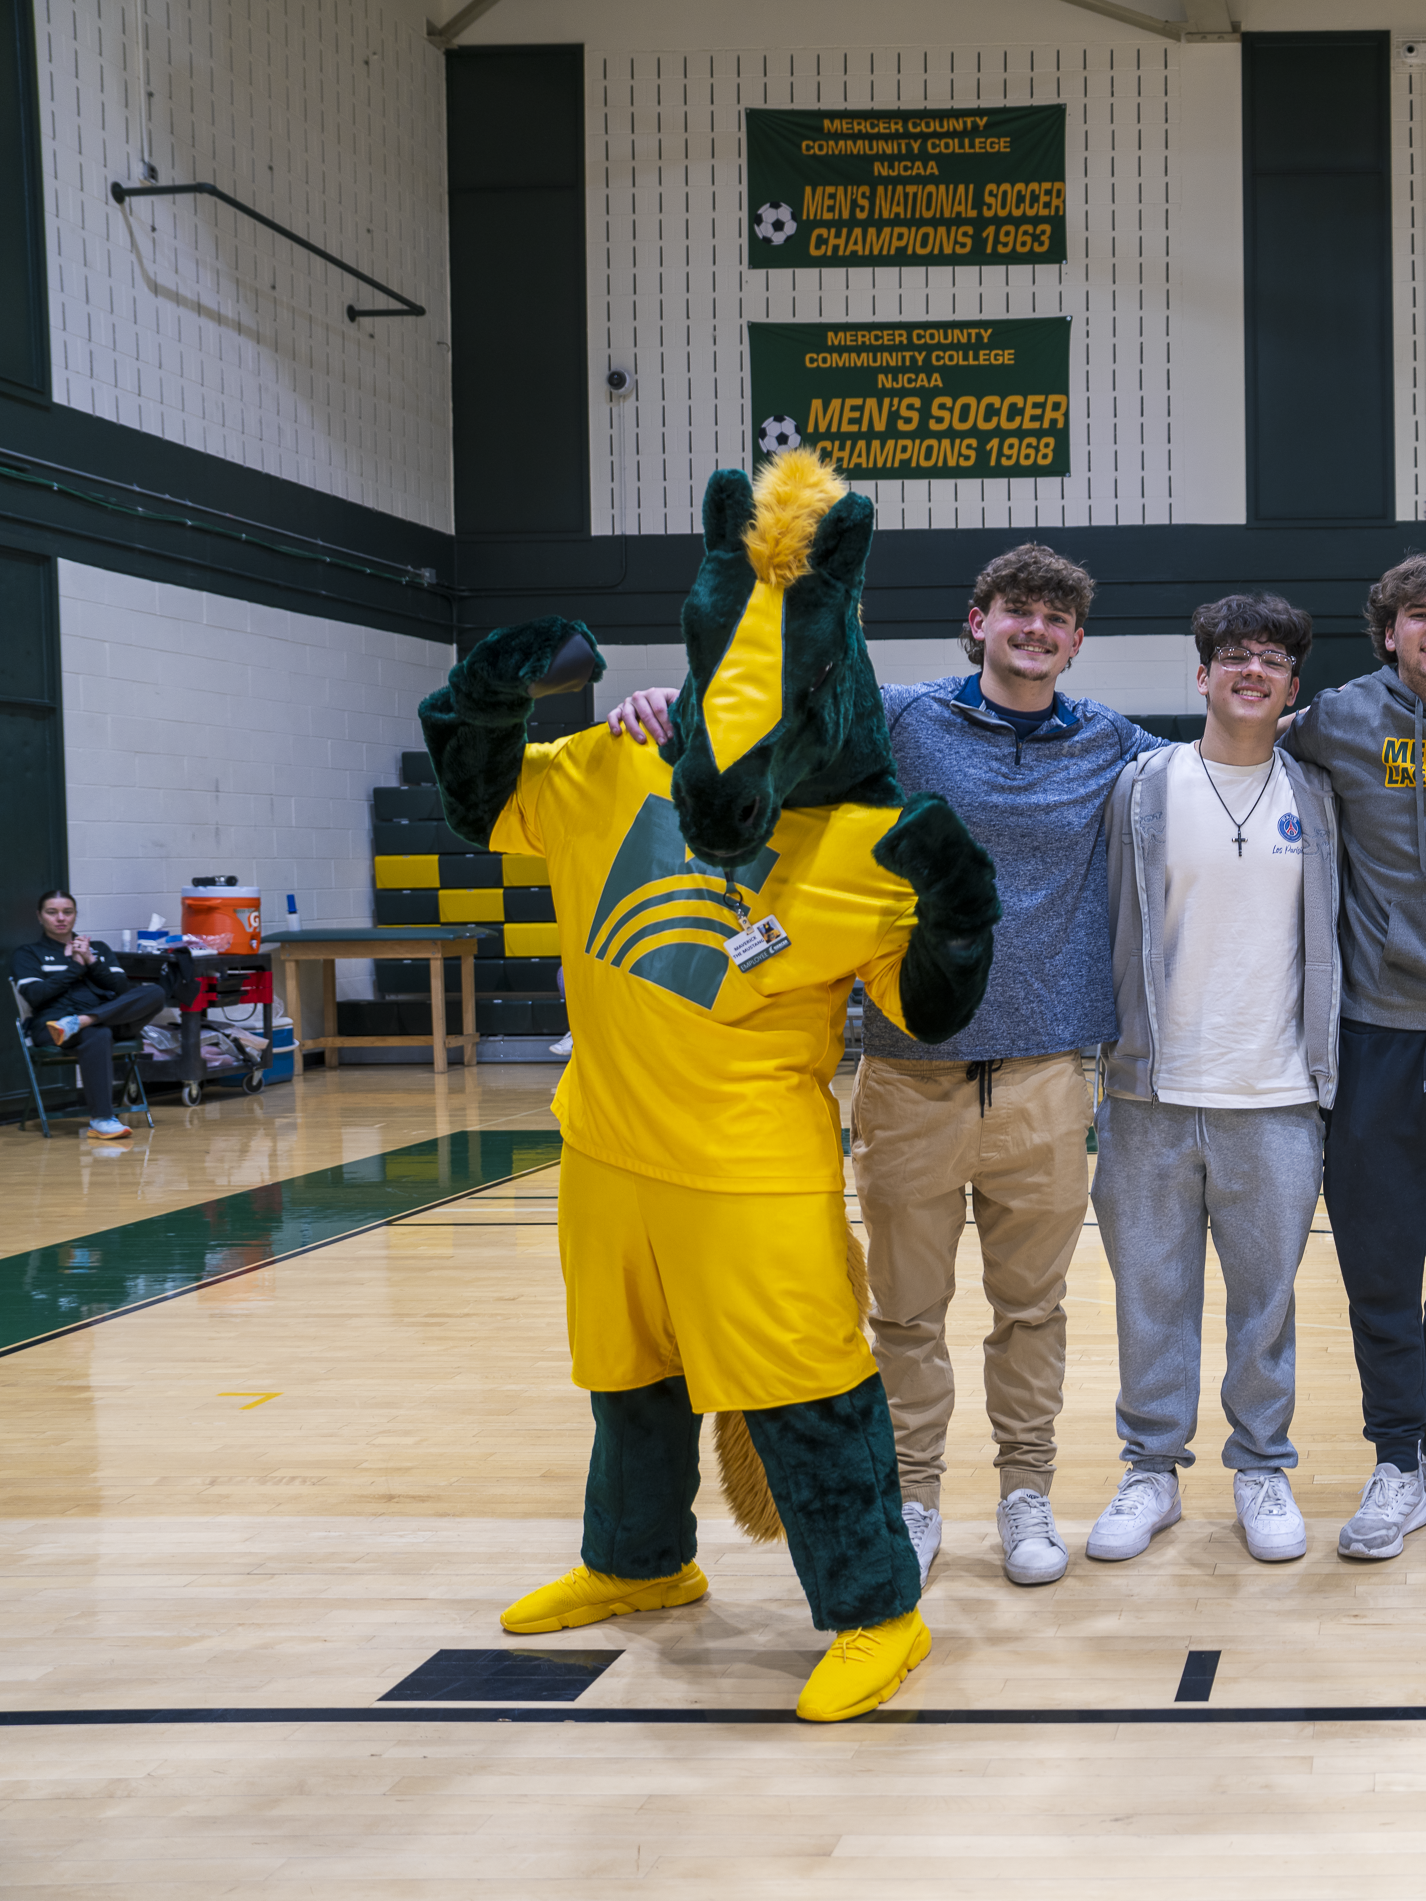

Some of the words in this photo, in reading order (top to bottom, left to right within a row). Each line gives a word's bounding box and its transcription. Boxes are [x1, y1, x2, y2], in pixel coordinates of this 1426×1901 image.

[823, 118, 904, 134] MERCER
[907, 116, 988, 133] COUNTY
[801, 138, 922, 155] COMMUNITY
[927, 137, 1011, 154] COLLEGE
[873, 160, 939, 176] NJCAA
[802, 184, 871, 220] MEN'S
[874, 183, 978, 219] NATIONAL
[982, 181, 1066, 218] SOCCER
[808, 225, 974, 257] CHAMPIONS
[981, 223, 1052, 254] 1963
[827, 329, 908, 346] MERCER
[912, 328, 993, 345] COUNTY
[804, 351, 927, 368] COMMUNITY
[931, 349, 1015, 366] COLLEGE
[877, 372, 944, 389] NJCAA
[806, 396, 922, 433] MEN'S
[928, 394, 1068, 431] SOCCER
[814, 437, 978, 469] CHAMPIONS
[985, 436, 1055, 467] 1968
[734, 935, 757, 951] MAVERICK
[742, 939, 764, 954] MUSTANG
[740, 951, 769, 971] EMPLOYEE
